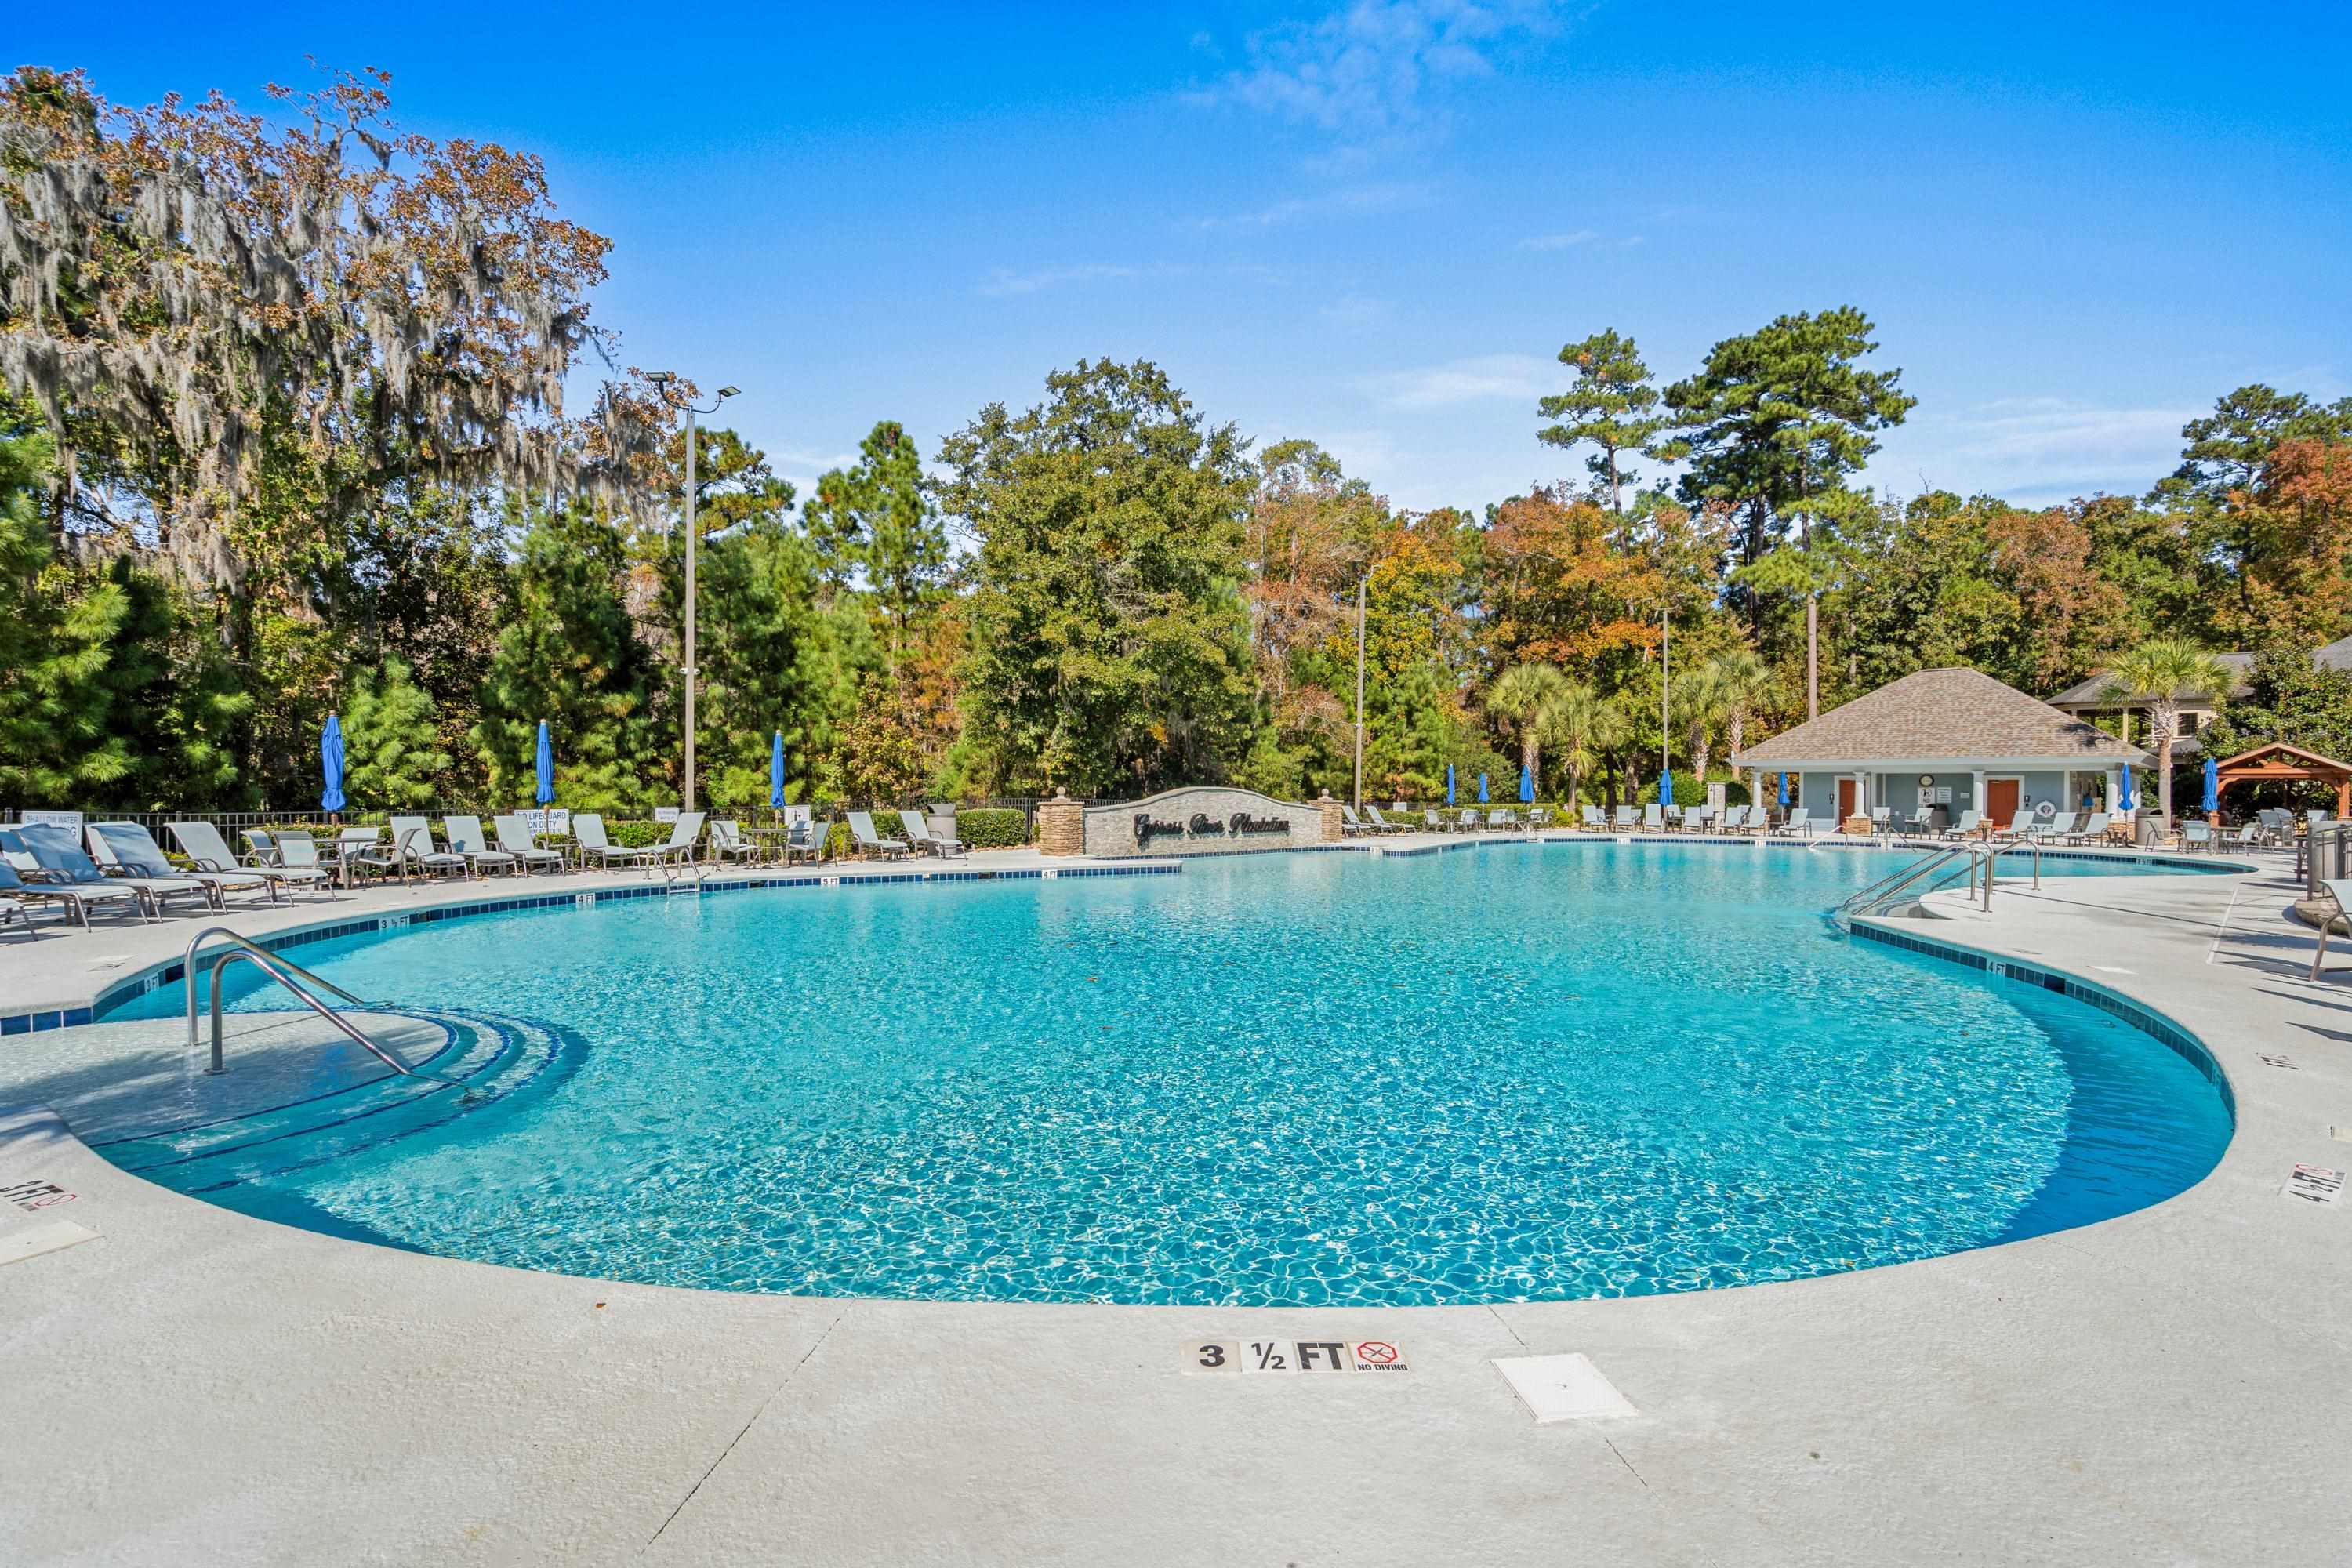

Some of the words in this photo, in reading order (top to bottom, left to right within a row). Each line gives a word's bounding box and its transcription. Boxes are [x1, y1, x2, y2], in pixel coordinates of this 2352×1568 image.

[586, 895, 594, 903] FT
[400, 916, 408, 928] FT
[4, 1185, 64, 1202] FT
[1199, 1345, 1225, 1367] 3
[1297, 1342, 1344, 1370] FT
